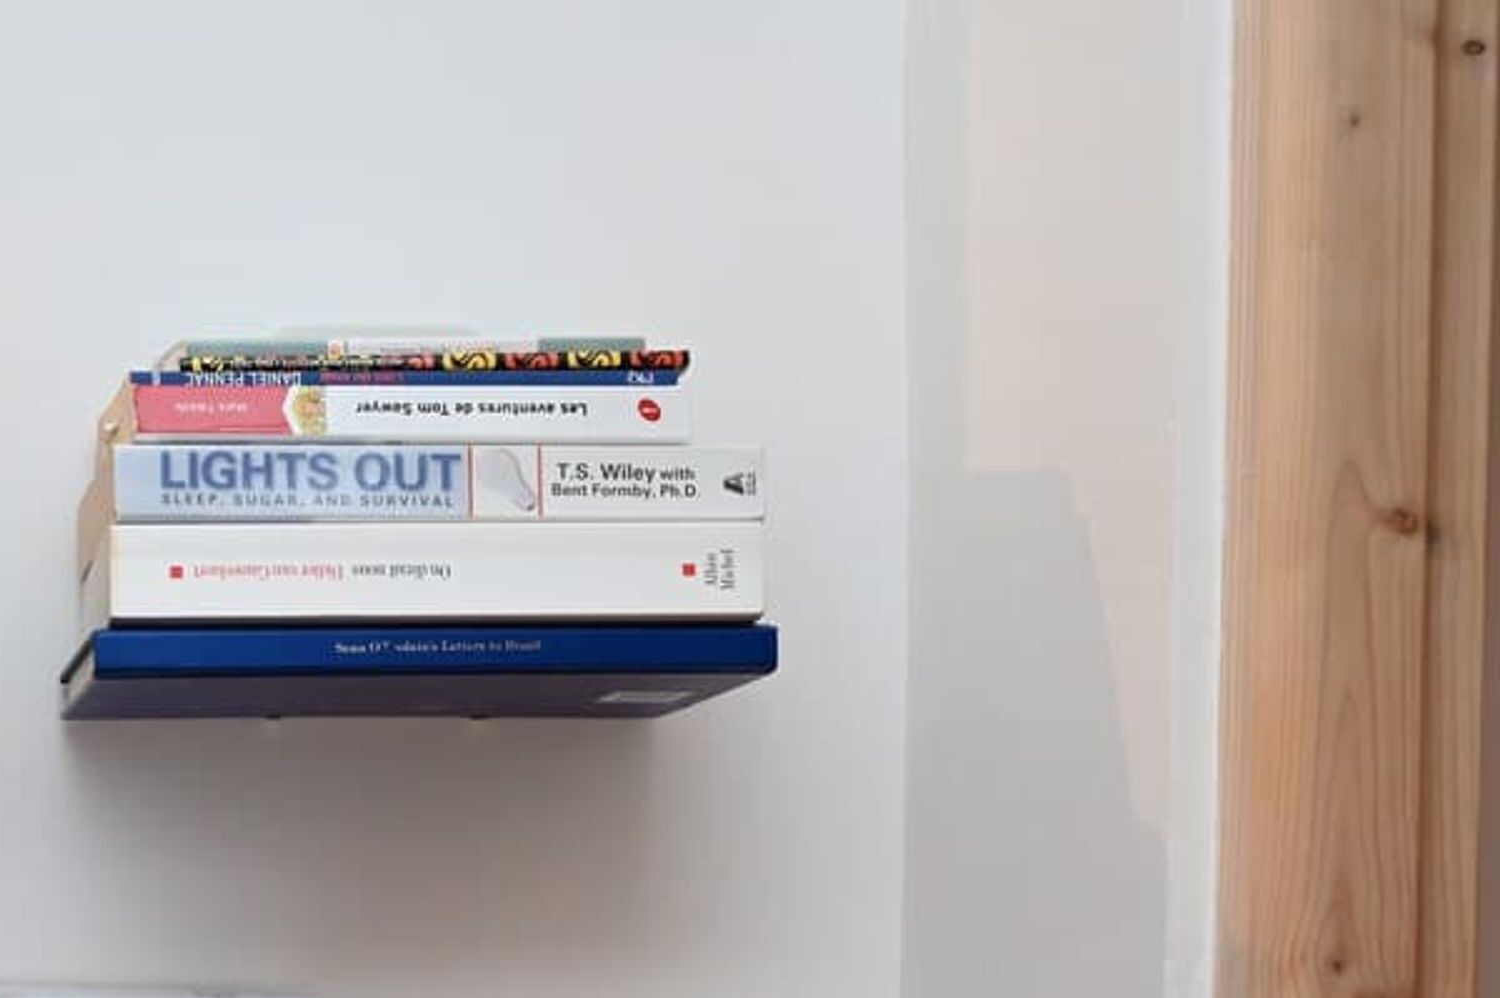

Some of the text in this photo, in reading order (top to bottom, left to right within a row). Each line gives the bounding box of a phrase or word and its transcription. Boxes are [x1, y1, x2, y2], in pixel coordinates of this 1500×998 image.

[356, 401, 588, 416] Les aventures de Tom Sawyer
[159, 450, 462, 492] LIGHTS OUT
[556, 462, 697, 483] T.S. Wiley with
[551, 483, 588, 497] Bent
[592, 483, 657, 499] Formby,
[314, 493, 351, 508] AND
[359, 493, 454, 508] SURVIVAL
